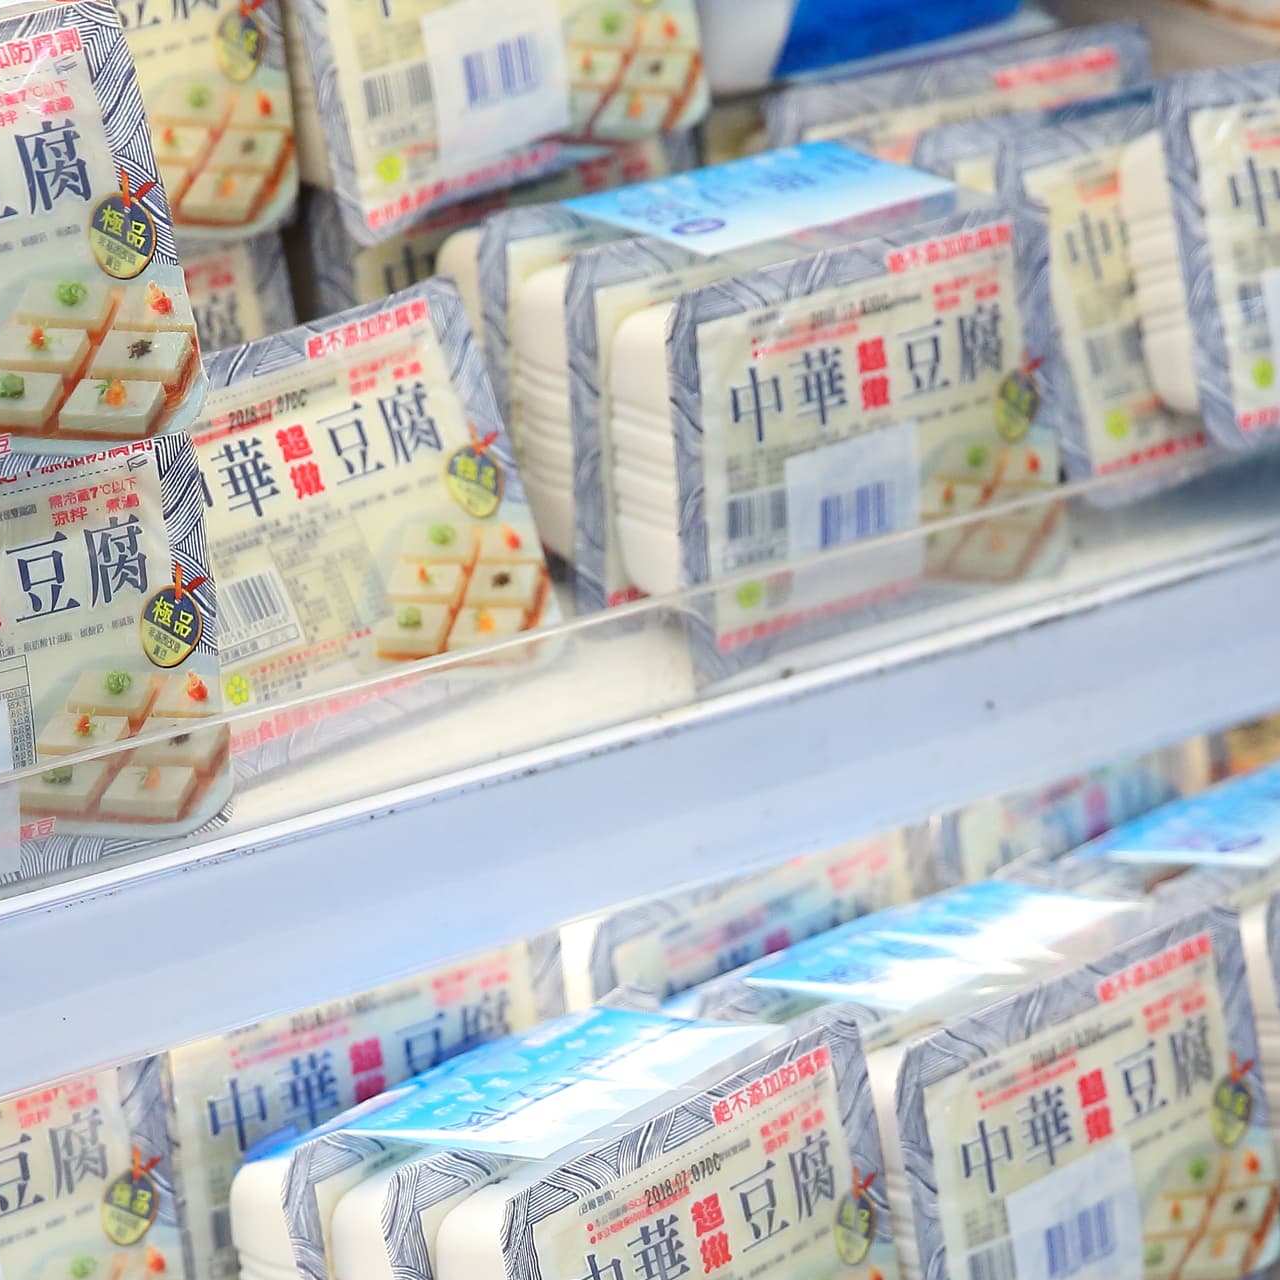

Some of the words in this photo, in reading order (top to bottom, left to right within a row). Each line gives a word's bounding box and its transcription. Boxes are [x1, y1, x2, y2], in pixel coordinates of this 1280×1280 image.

[98, 203, 148, 250] 極品
[729, 344, 852, 444] 中華
[904, 302, 1006, 397] 豆腐
[317, 381, 443, 485] 豆腐
[6, 513, 150, 624] 豆腐
[151, 595, 195, 640] 極品
[712, 1045, 832, 1127] 絕不添加防腐劑
[961, 1087, 1072, 1194] 中華
[1115, 1009, 1214, 1117] 豆腐
[644, 1152, 721, 1207] 2018.07.07DC
[690, 1193, 732, 1275] 超嫩
[730, 1130, 835, 1253] 豆腐
